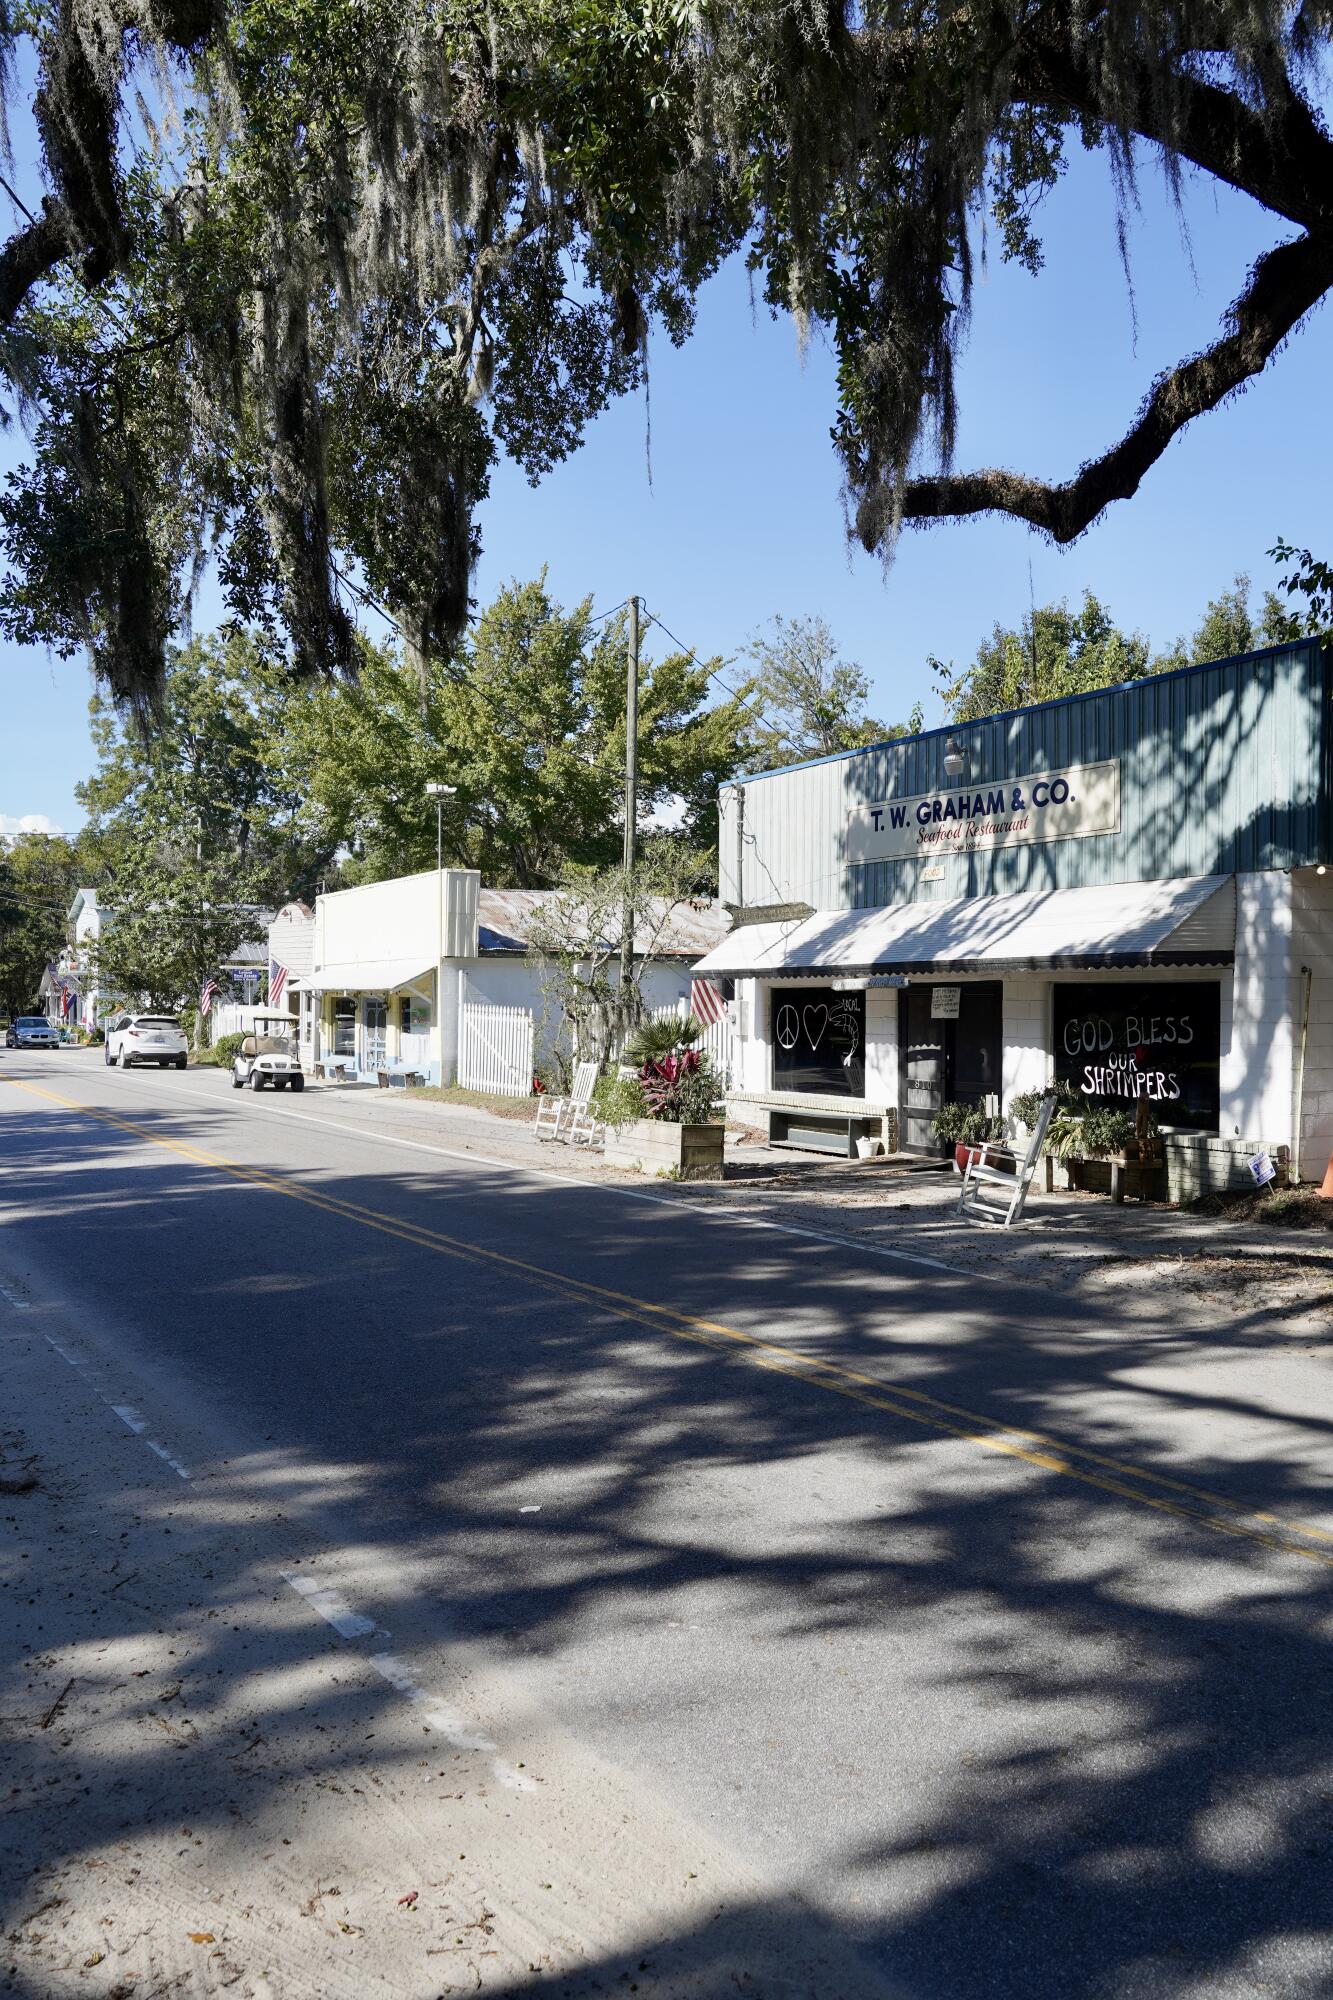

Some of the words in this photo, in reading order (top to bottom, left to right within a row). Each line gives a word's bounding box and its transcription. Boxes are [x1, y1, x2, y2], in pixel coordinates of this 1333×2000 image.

[870, 809, 885, 832] T.
[890, 805, 911, 829] W.
[916, 790, 1005, 825] GRAHAM
[1011, 787, 1026, 811] &
[1032, 778, 1076, 808] CO.
[917, 822, 961, 846] Seafood
[965, 815, 1029, 839] Restaurant
[842, 998, 860, 1012] LOCAL
[1063, 1018, 1113, 1056] GOD
[1125, 1015, 1194, 1048] BLESS
[1108, 1051, 1138, 1072] OUR
[1080, 1065, 1181, 1100] SHRIMPERS
